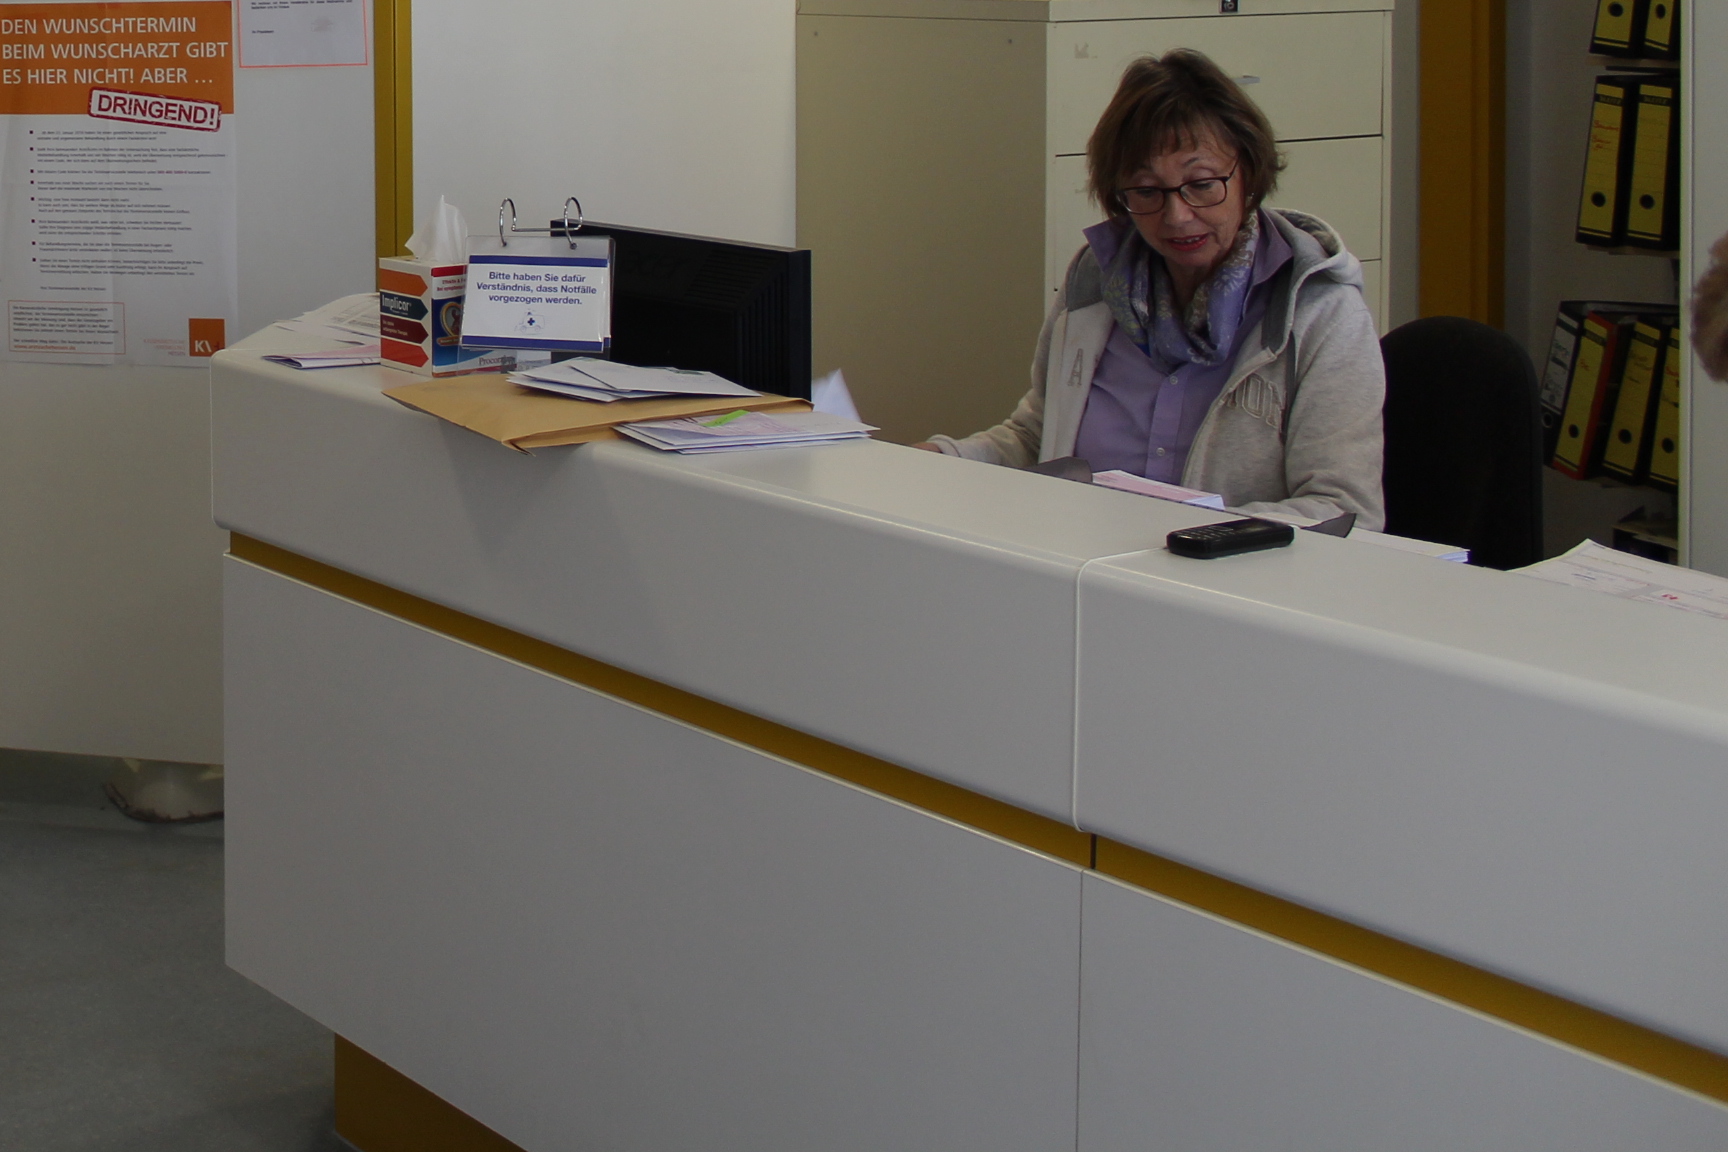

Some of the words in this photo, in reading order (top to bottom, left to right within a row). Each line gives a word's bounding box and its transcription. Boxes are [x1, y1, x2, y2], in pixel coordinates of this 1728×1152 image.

[1, 19, 37, 34] DEN
[43, 17, 196, 34] WUNSCHTERMIN
[2, 44, 45, 59] BEIM
[51, 42, 180, 59] WUNSCHARZT
[186, 42, 228, 58] GIBT
[3, 69, 21, 84] ES
[28, 68, 68, 84] HIER
[74, 68, 134, 84] NICHT!
[140, 68, 188, 84] ABER
[98, 94, 215, 126] DRINGEND!
[489, 271, 510, 281] Bitte
[513, 272, 541, 282] haben
[544, 273, 559, 282] Sie
[561, 274, 586, 283] dafür
[476, 282, 533, 293] Verständnis,
[536, 284, 558, 294] dass
[560, 285, 597, 294] Notfälle
[382, 294, 410, 311] Implicor
[488, 295, 543, 304] vorgezogen
[545, 295, 582, 305] werden.
